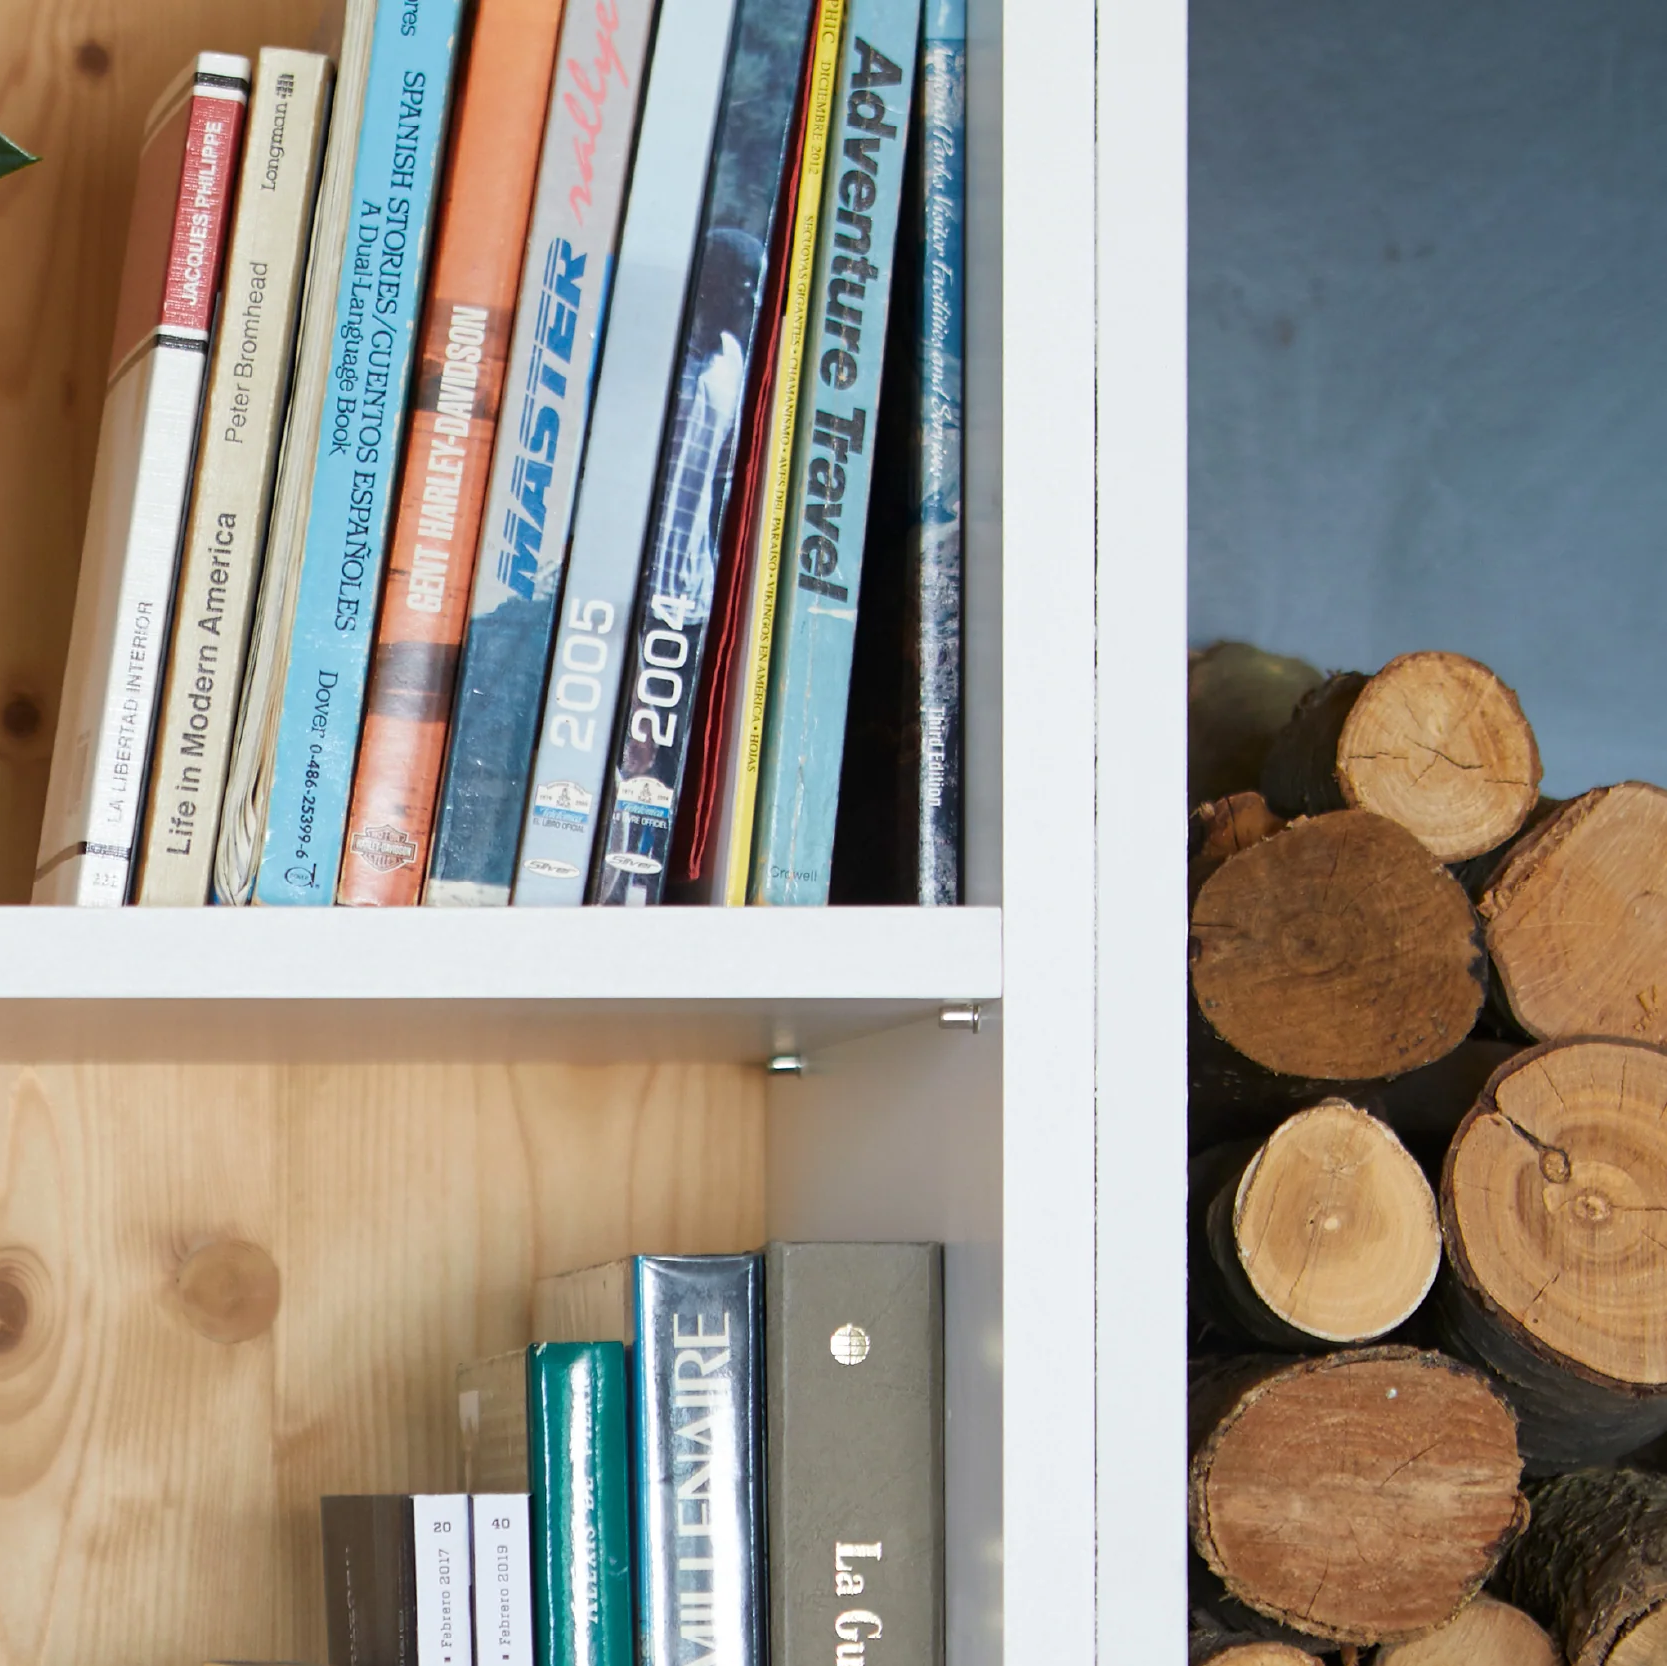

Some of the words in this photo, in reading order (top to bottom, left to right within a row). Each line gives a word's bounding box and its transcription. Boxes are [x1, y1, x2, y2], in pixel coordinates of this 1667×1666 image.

[389, 70, 428, 191] SPANISH
[563, 0, 629, 227] rallye
[811, 61, 831, 141] DICIEMBRE
[194, 119, 223, 208] PHILIPPE
[260, 100, 290, 192] Longman
[808, 145, 821, 175] 2012
[931, 130, 956, 190] Parks
[360, 200, 381, 220] A
[819, 36, 903, 391] Adventure
[932, 195, 953, 256] Visitor
[181, 212, 210, 306] JACQUES
[929, 259, 954, 348] Facilities
[233, 260, 268, 378] Bromhead
[332, 223, 379, 393] Dual-Language
[353, 196, 413, 465] STORIES/CUENTOS
[223, 382, 251, 444] Peter
[328, 395, 357, 458] Book
[413, 304, 490, 541] HARLEY-DAVIDSON
[498, 237, 587, 600] MASTER
[798, 408, 867, 603] Travel
[196, 510, 236, 636] America
[333, 469, 380, 633] ESPAÑOLES
[403, 542, 451, 614] GENT
[124, 600, 153, 693] INTERIOR
[546, 594, 617, 753] 2005
[629, 589, 696, 747] 2004
[110, 697, 139, 792] LIBERTAD
[180, 643, 218, 757] Modern
[309, 669, 339, 739] Dover
[926, 706, 945, 747] Third
[175, 764, 201, 792] in
[293, 743, 323, 860] 0-486-25399-6
[927, 751, 946, 807] Edition
[166, 799, 196, 856] Life
[433, 1522, 451, 1533] 20
[438, 1547, 450, 1584] 2017
[492, 1518, 510, 1529] 40
[497, 1544, 509, 1581] 2019
[833, 1540, 882, 1595] La
[439, 1590, 452, 1647] Febrero
[497, 1587, 510, 1645] Febrero
